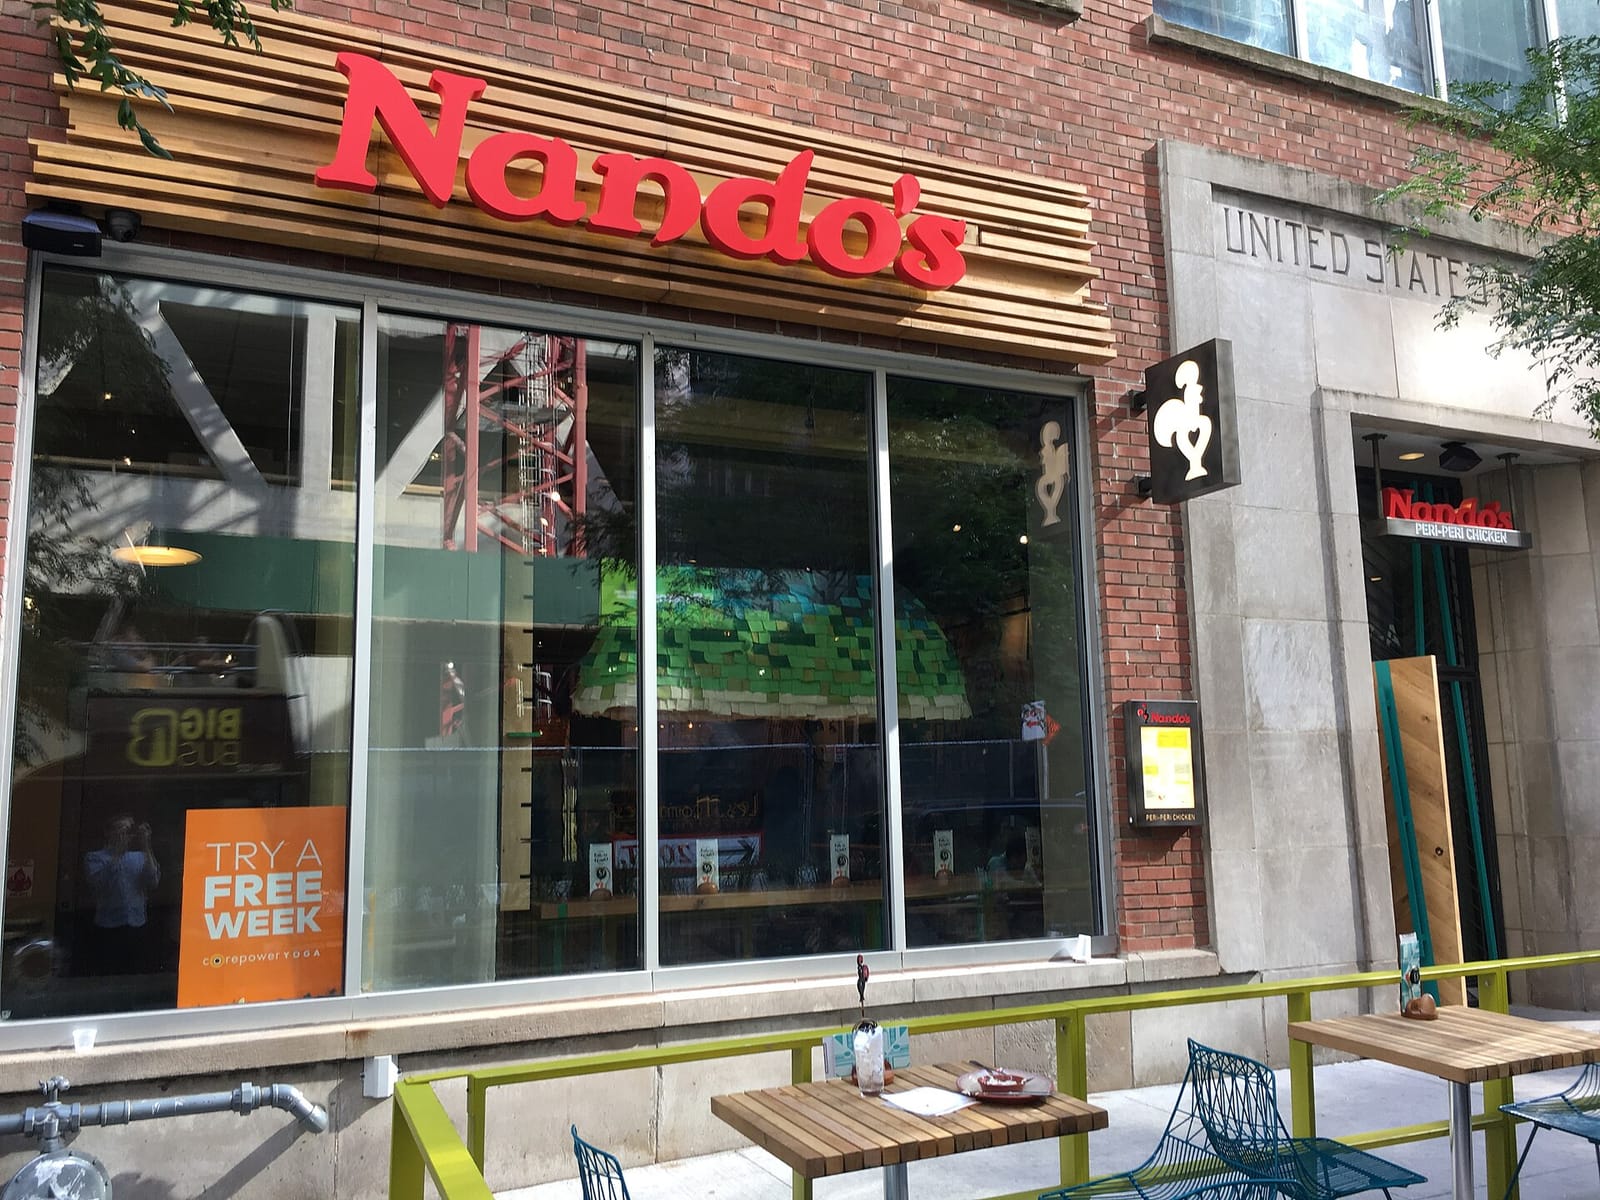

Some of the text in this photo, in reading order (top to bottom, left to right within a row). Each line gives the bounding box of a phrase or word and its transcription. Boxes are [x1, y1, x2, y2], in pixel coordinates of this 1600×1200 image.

[314, 51, 968, 291] Nando's
[1223, 207, 1352, 276] UNITED
[1382, 487, 1513, 529] Nando's
[1415, 522, 1508, 544] PERI-PERI CHICKEN
[1151, 711, 1191, 723] Nando's
[206, 839, 322, 872] TRY A
[204, 870, 323, 909] FREE
[204, 906, 322, 940] WEEK
